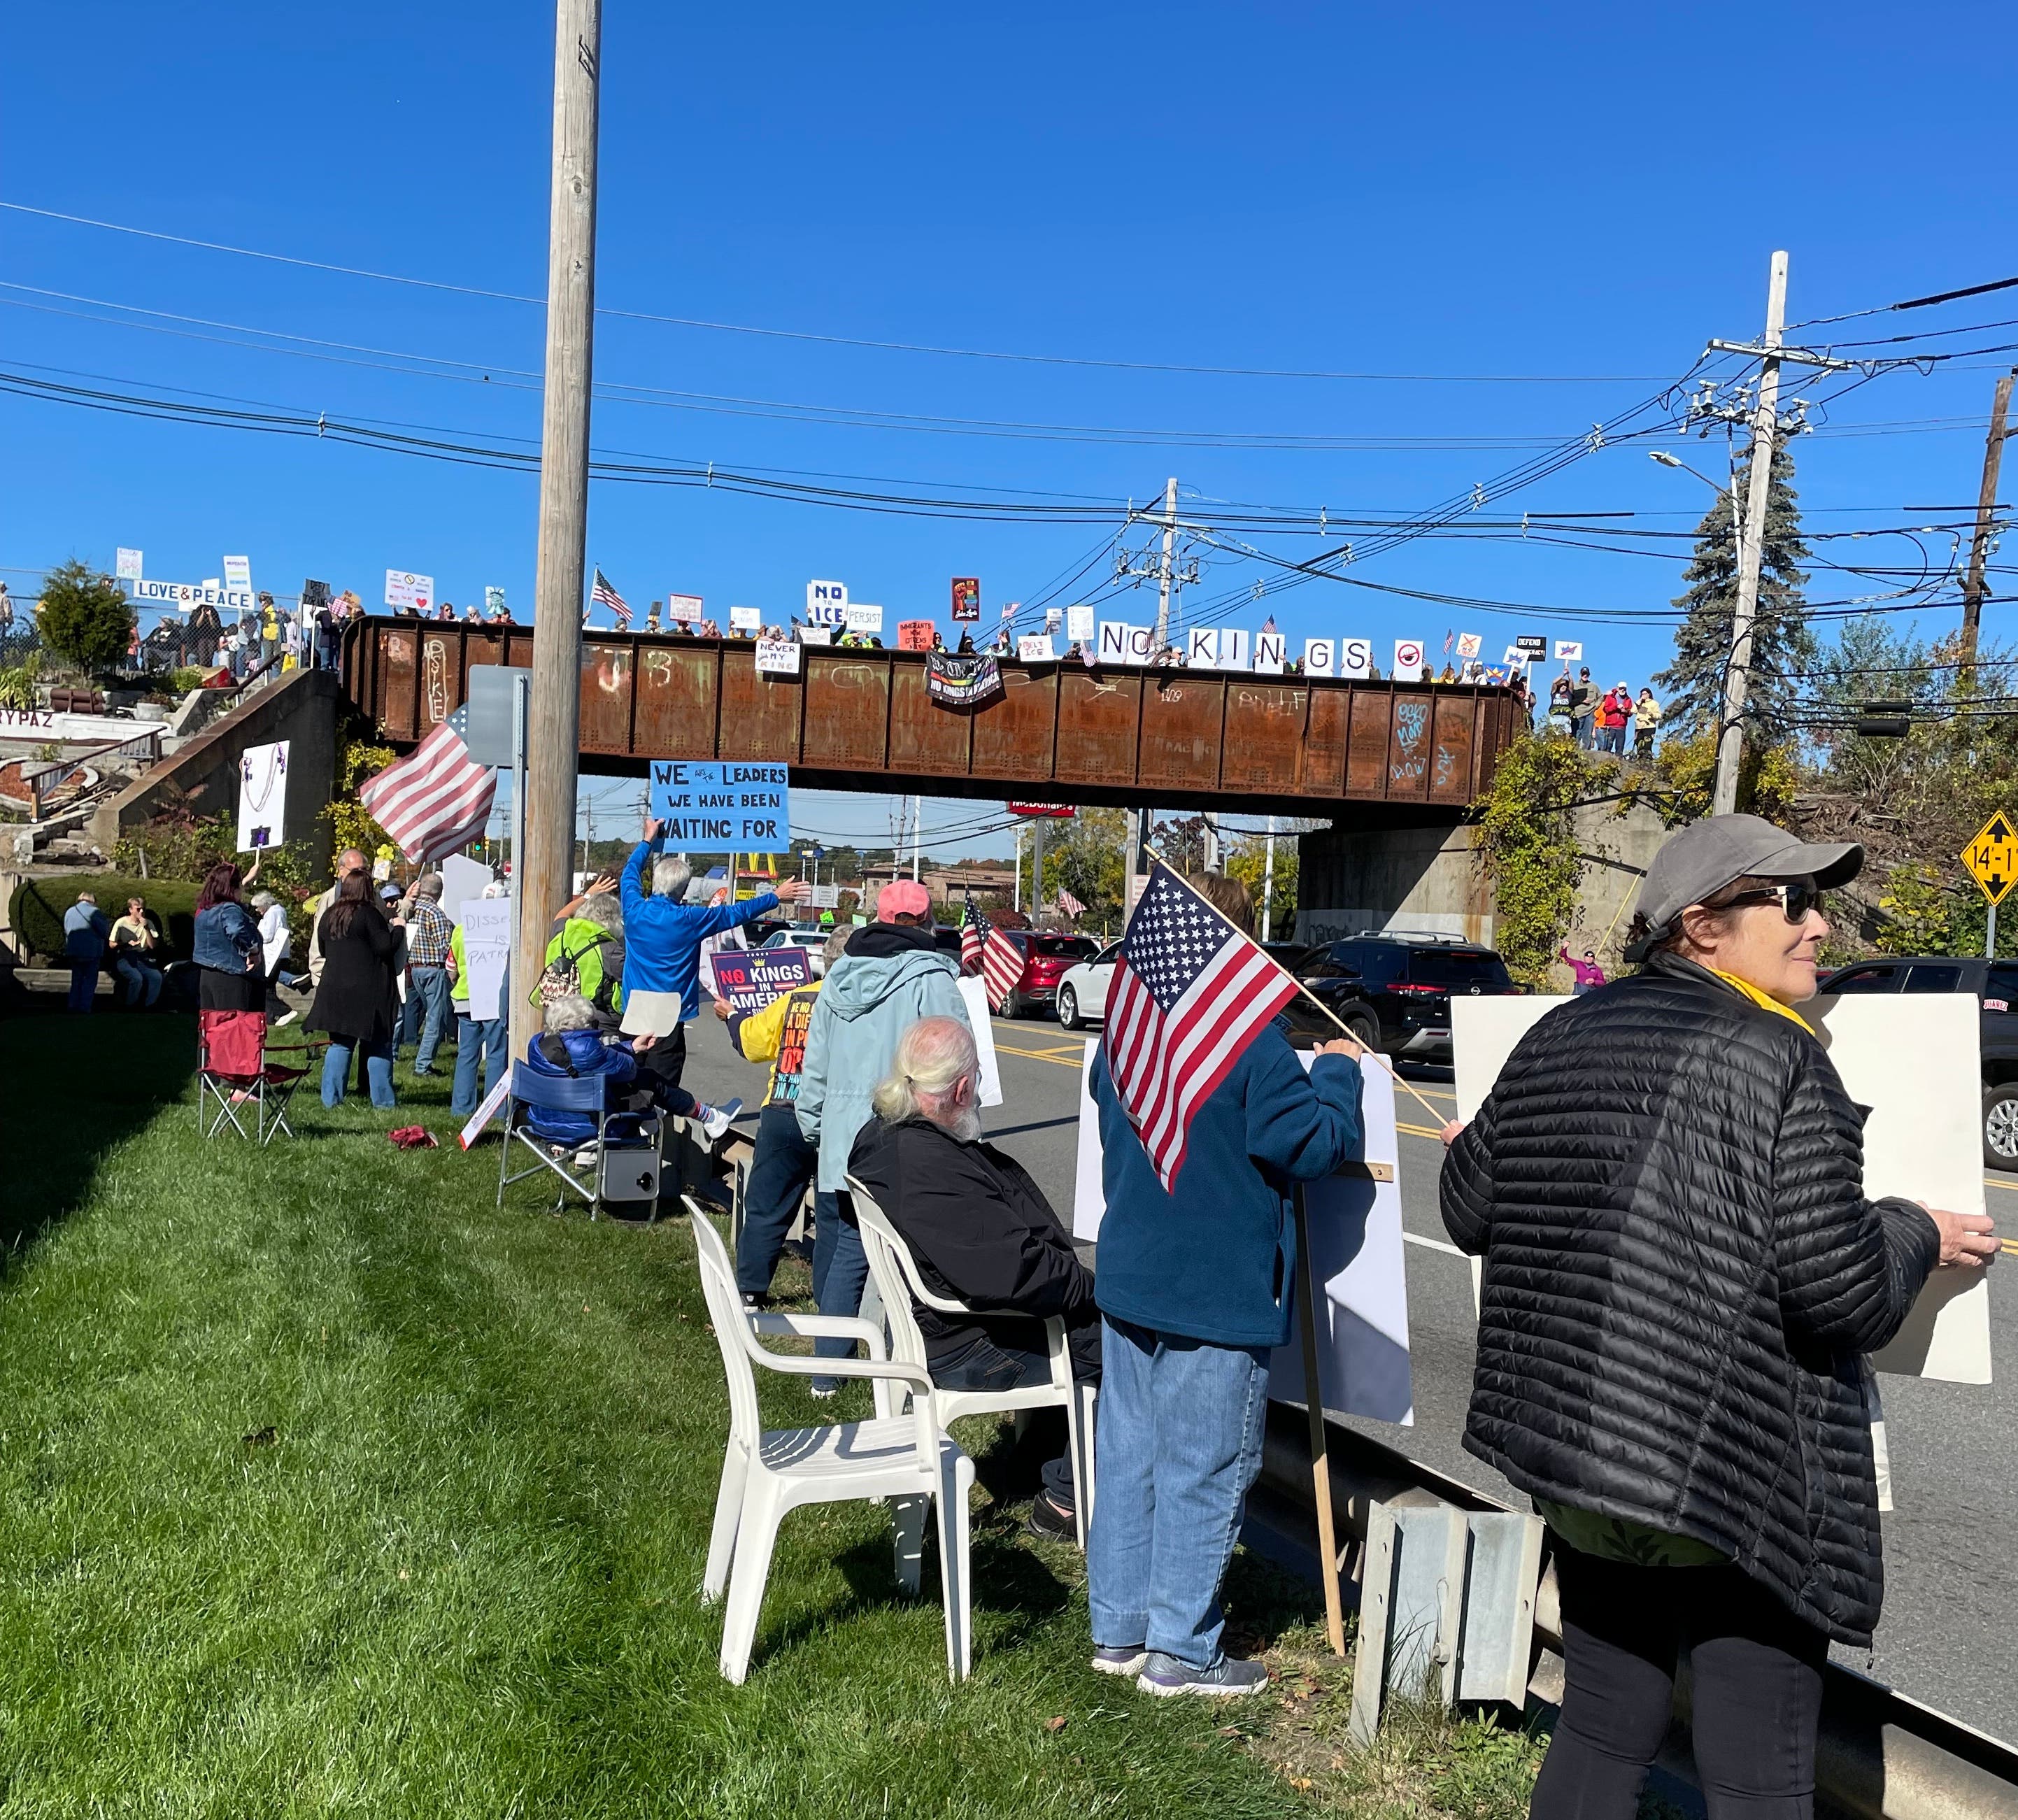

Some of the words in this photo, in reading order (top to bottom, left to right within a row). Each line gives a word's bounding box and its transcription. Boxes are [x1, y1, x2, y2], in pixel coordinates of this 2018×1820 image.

[139, 582, 178, 599] LOVE
[193, 588, 249, 607] PEACE
[816, 585, 842, 599] NO
[816, 607, 843, 623] ICE
[848, 611, 881, 624] PERSIST
[760, 643, 795, 653] NEVER
[1103, 625, 1151, 655] NO
[1193, 632, 1365, 670] KINGS
[1518, 638, 1541, 646] DEFEND
[930, 678, 942, 692] NO
[942, 684, 965, 697] KINGS
[0, 710, 54, 728] YPAZ
[654, 765, 689, 785] WE
[723, 765, 786, 785] LEADERS
[667, 795, 691, 807] WE
[699, 795, 734, 807] HAVE
[741, 793, 780, 807] BEEN
[743, 820, 778, 839] FOR
[464, 914, 511, 931] DISSE
[495, 934, 509, 946] IS
[467, 950, 508, 967] PATR
[720, 968, 746, 985] NO
[749, 965, 804, 983] KINGS
[759, 982, 772, 992] IN
[730, 990, 784, 1009] AMER
[800, 1002, 811, 1013] NO
[787, 1014, 793, 1029] A
[795, 1014, 811, 1030] DIF
[785, 1030, 795, 1047] IN
[778, 1074, 788, 1082] WE
[774, 1083, 786, 1099] IN
